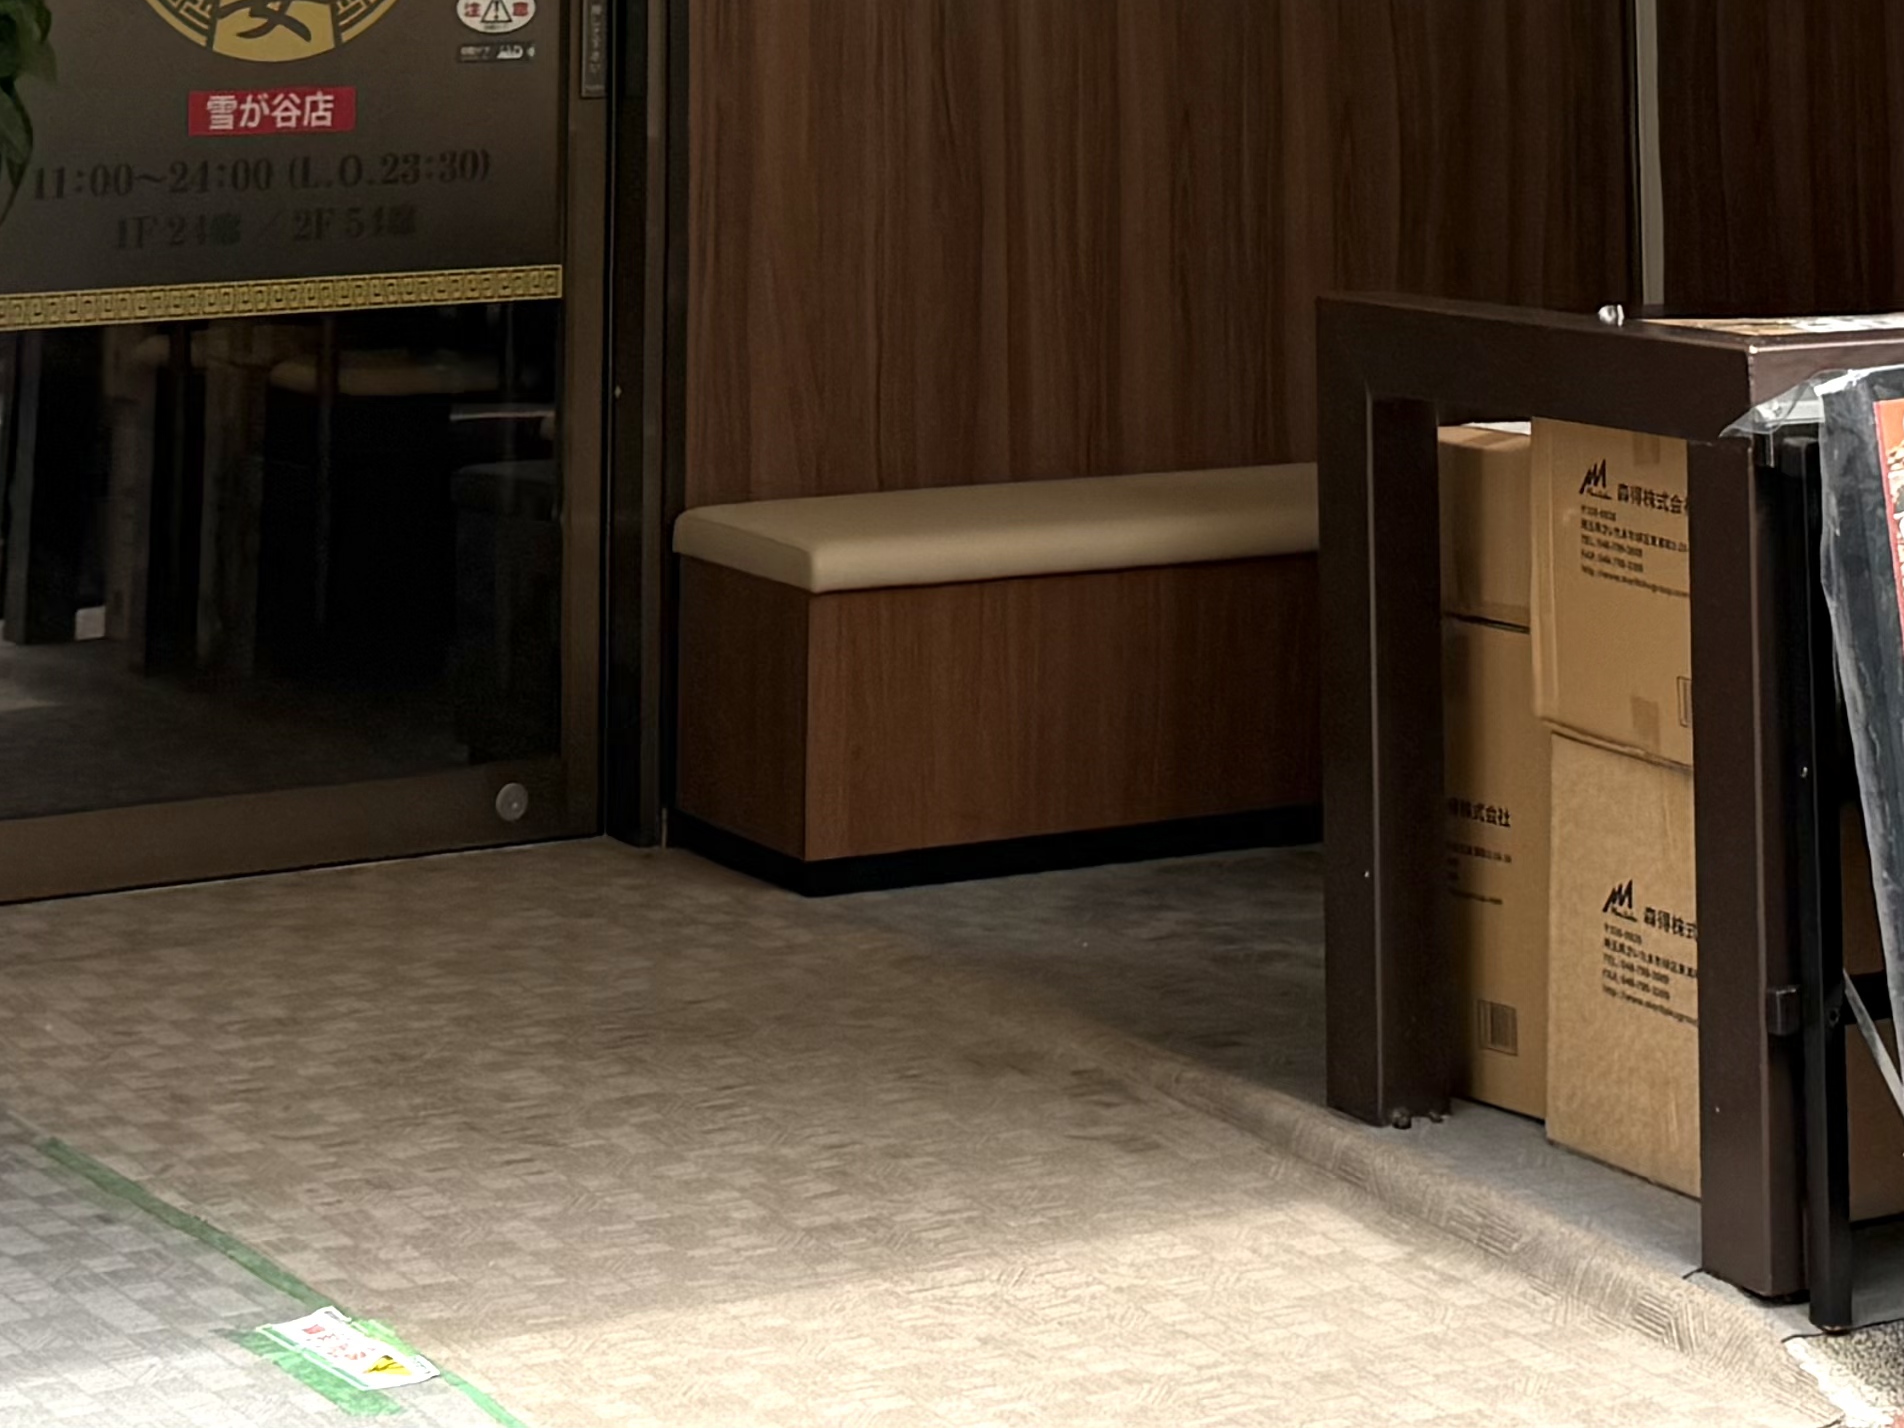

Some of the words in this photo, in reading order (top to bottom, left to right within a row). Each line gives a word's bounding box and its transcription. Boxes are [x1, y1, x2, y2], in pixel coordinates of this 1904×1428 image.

[204, 91, 335, 130] 雪が谷店
[1617, 482, 1689, 515] 森得株式会
